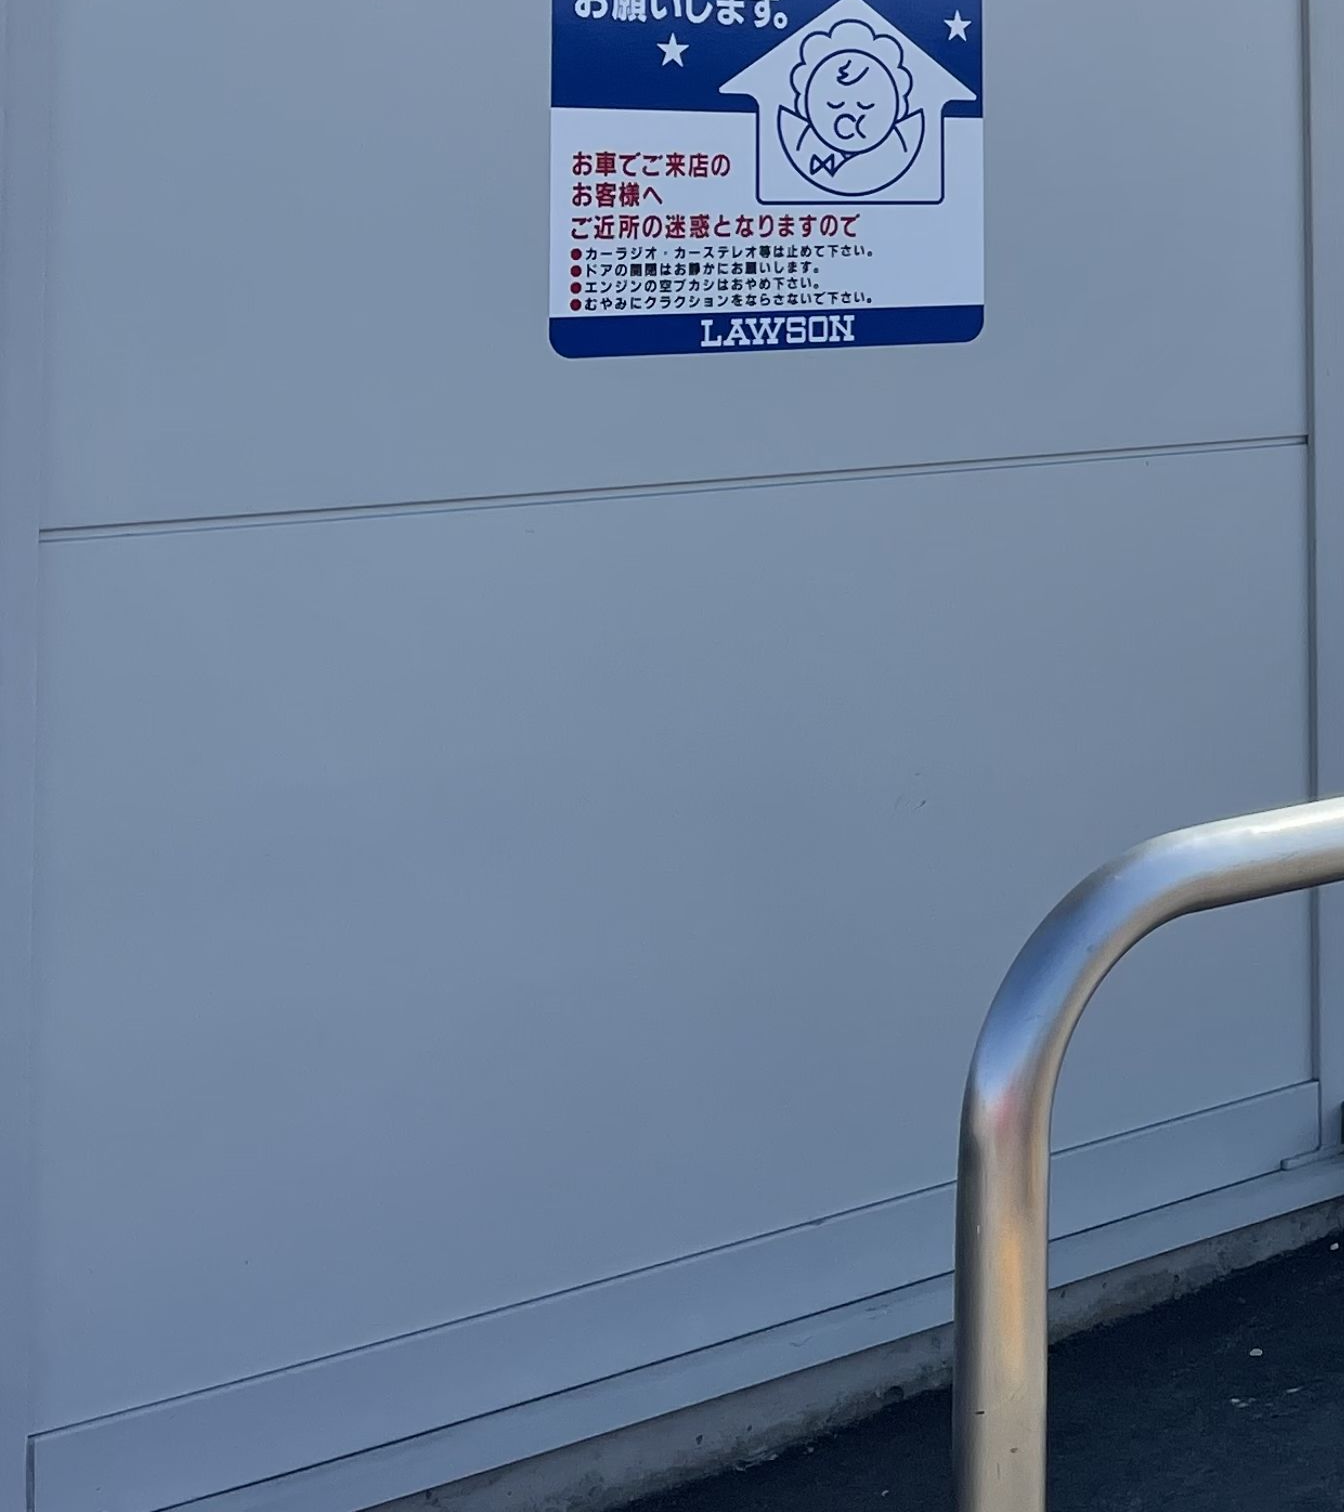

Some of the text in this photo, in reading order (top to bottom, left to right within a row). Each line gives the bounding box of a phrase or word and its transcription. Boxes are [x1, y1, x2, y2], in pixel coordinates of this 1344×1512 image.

[571, 152, 731, 178] お車でご来店の
[571, 183, 663, 207] お客様へ
[570, 214, 860, 240] ご近所の迷惑となりますので
[701, 315, 855, 347] LAWSON
